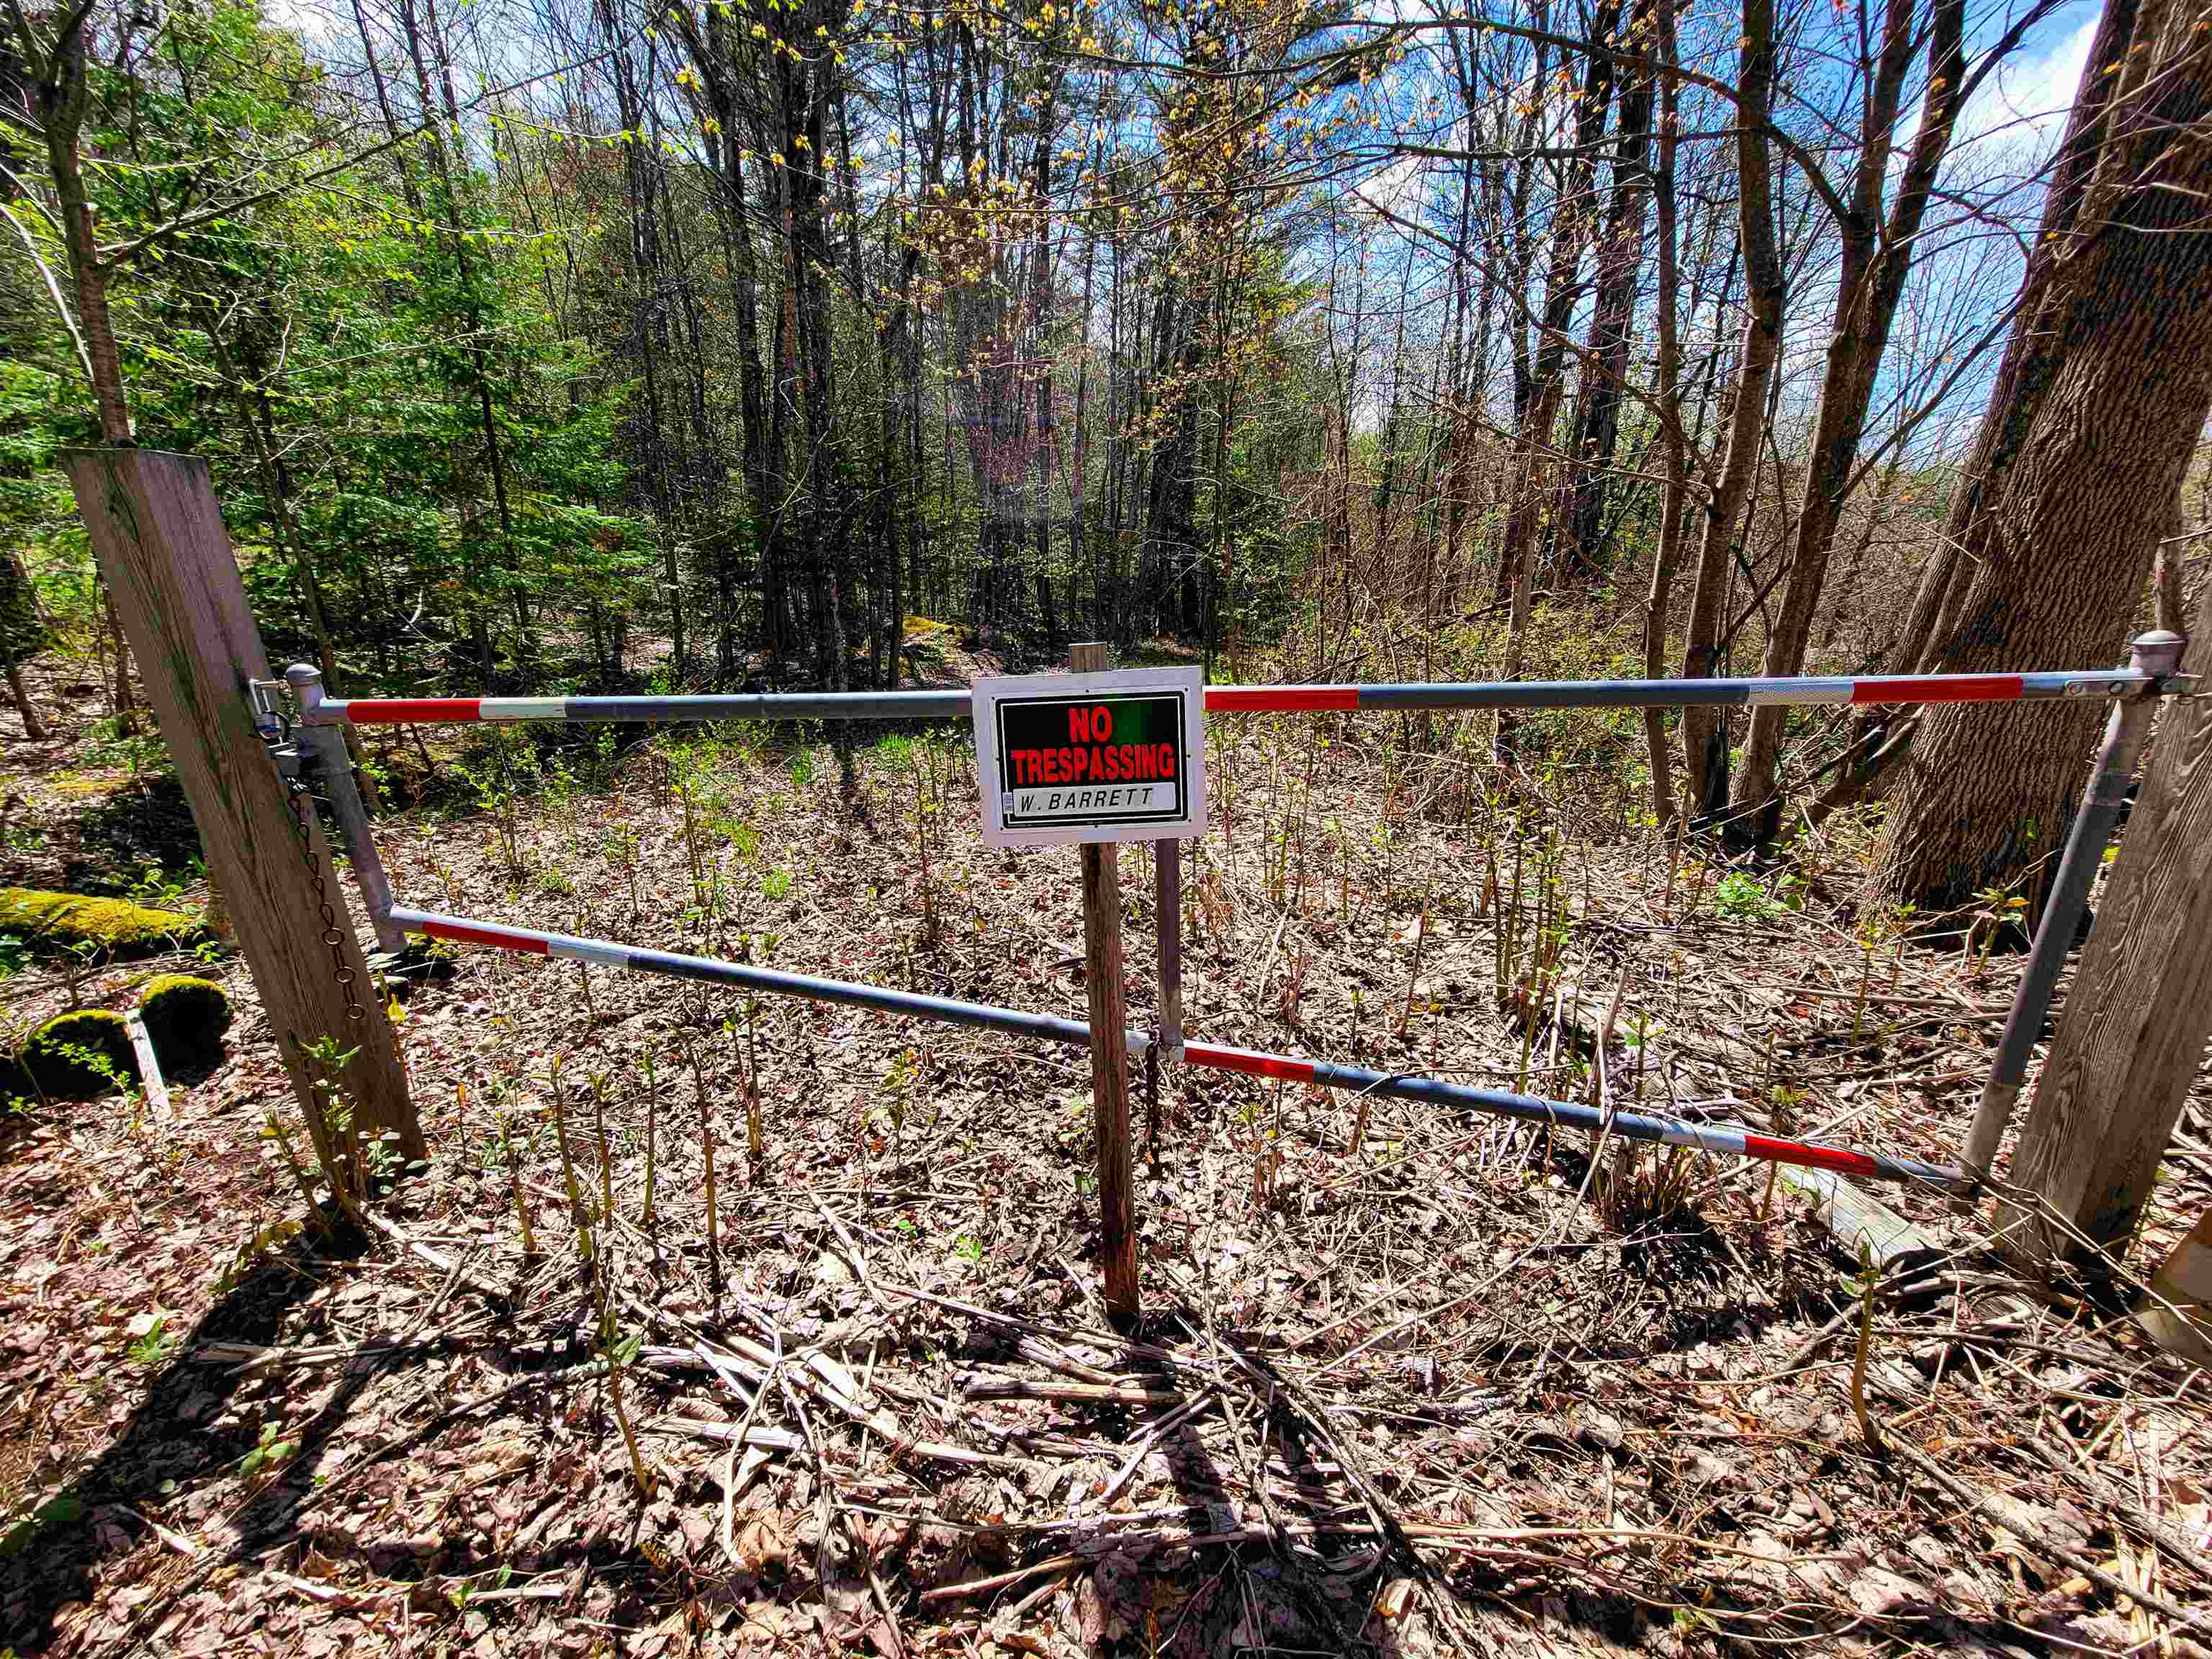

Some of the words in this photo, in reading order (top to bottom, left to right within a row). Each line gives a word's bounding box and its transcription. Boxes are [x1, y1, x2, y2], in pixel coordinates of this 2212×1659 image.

[1069, 706, 1113, 742] NO
[1012, 743, 1176, 784] TRESPASSING
[1020, 794, 1042, 812] W.
[1048, 788, 1154, 810] BARRETT
